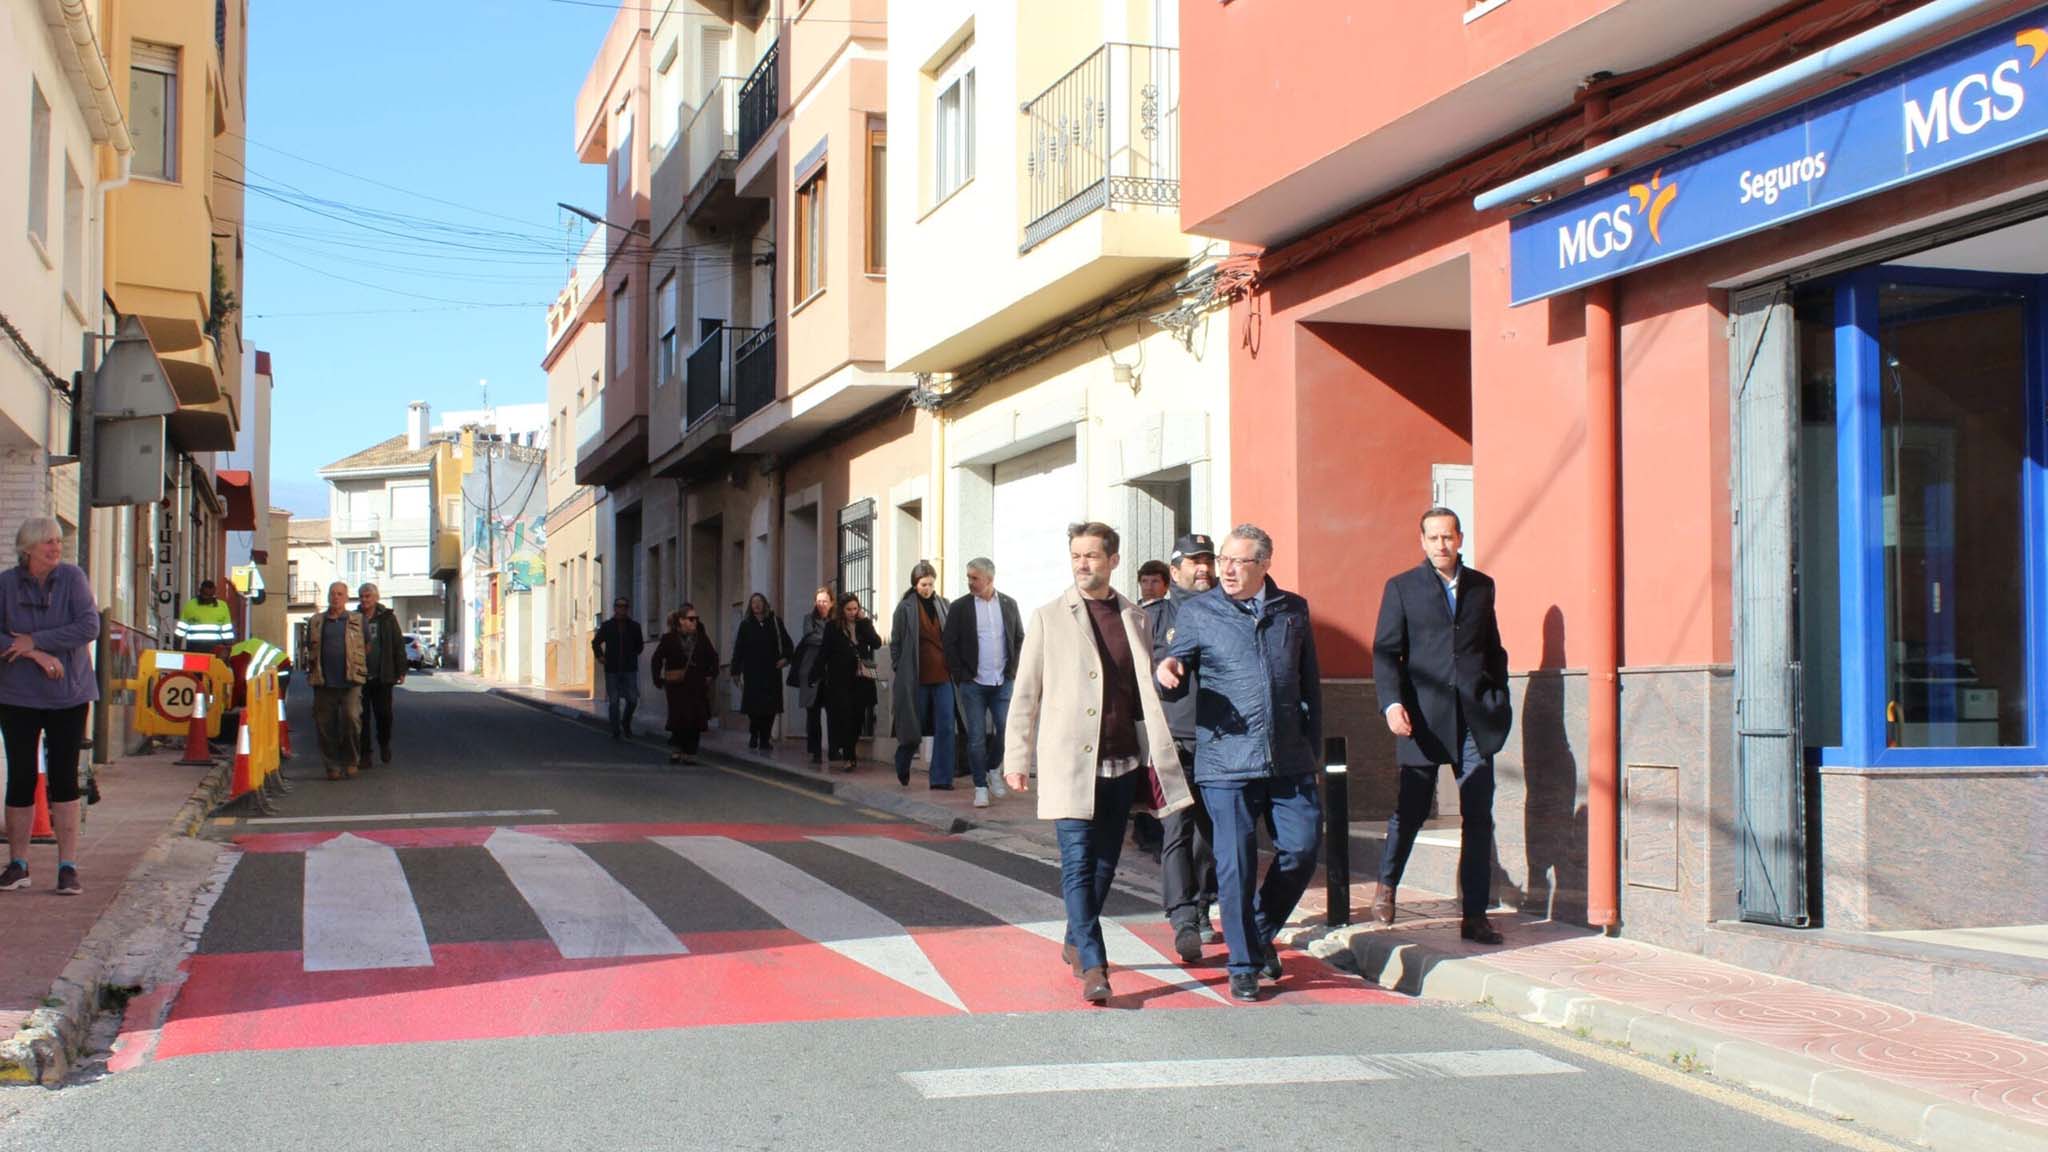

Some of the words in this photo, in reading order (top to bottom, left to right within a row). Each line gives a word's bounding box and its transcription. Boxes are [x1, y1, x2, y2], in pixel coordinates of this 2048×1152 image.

[1558, 204, 1633, 269] MGS
[1740, 152, 1826, 205] Seguros
[1904, 59, 2024, 154] MGS
[167, 687, 194, 706] 20
